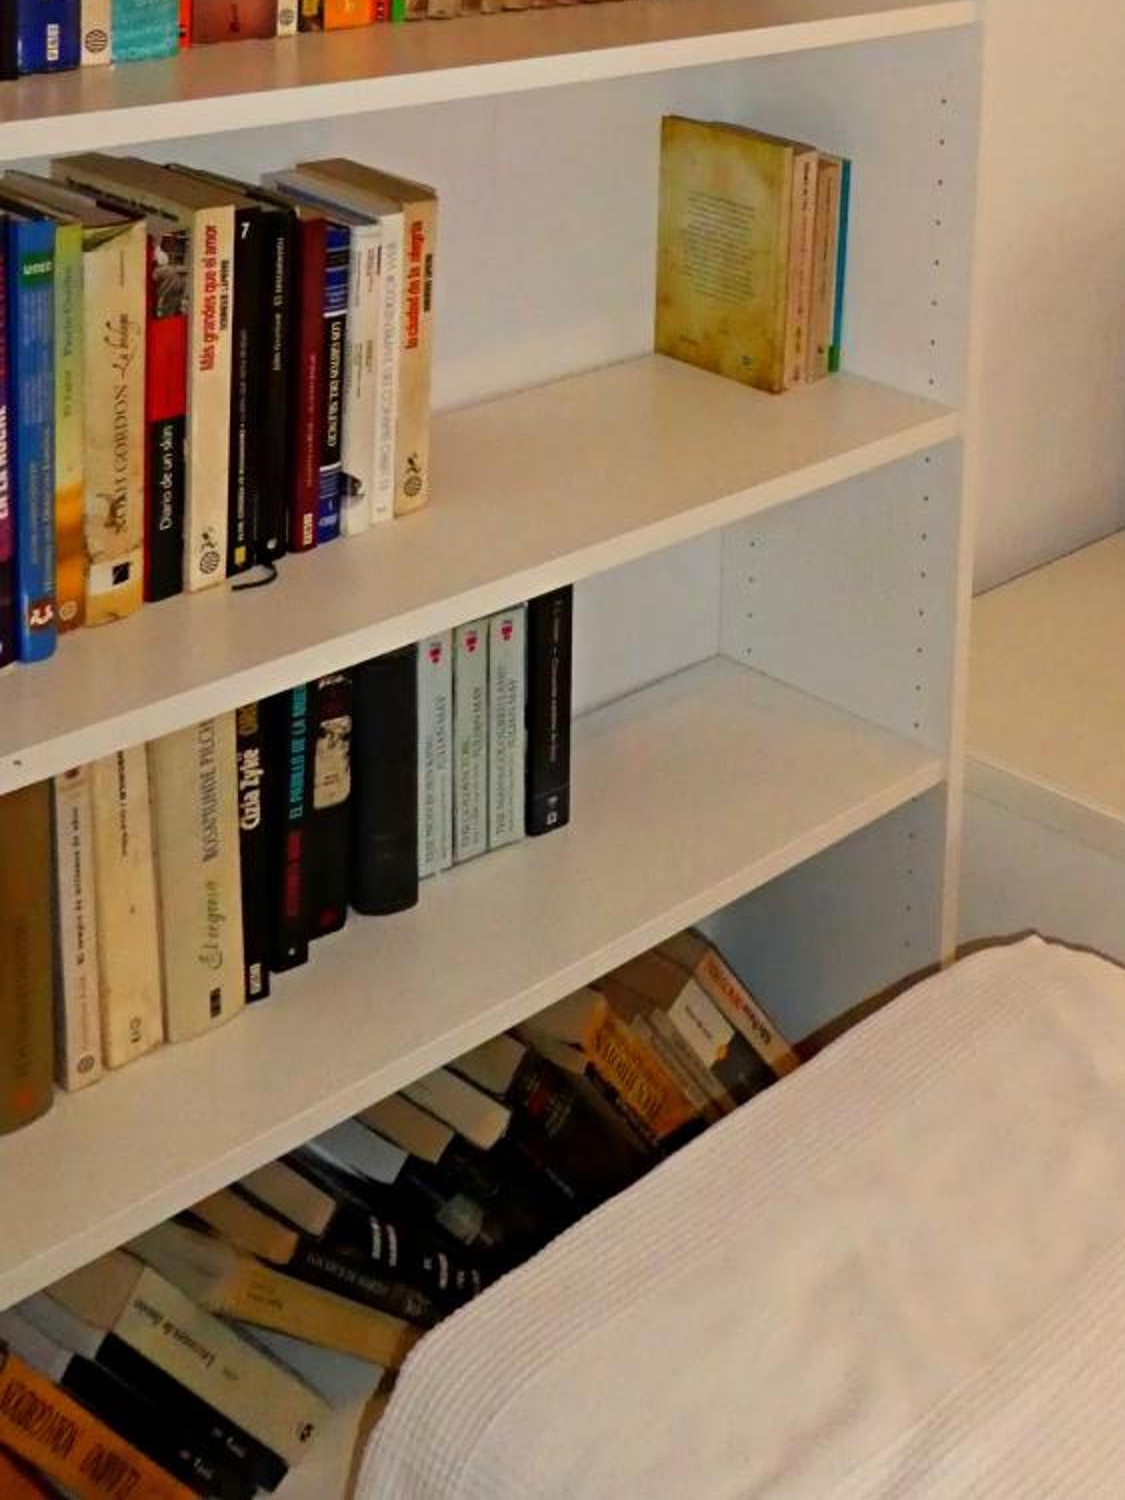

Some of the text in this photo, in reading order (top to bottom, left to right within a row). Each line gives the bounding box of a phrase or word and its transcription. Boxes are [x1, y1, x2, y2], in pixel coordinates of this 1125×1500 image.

[240, 221, 251, 240] 7
[407, 266, 420, 279] la
[407, 280, 420, 295] de
[200, 225, 219, 372] Más grandes que el amor
[406, 297, 419, 336] ciudad
[405, 338, 418, 350] la
[112, 385, 128, 473] GORDON
[159, 425, 173, 531] Diario de un skin
[200, 768, 218, 862] ROSAMUNDE
[239, 788, 260, 832] Cizia
